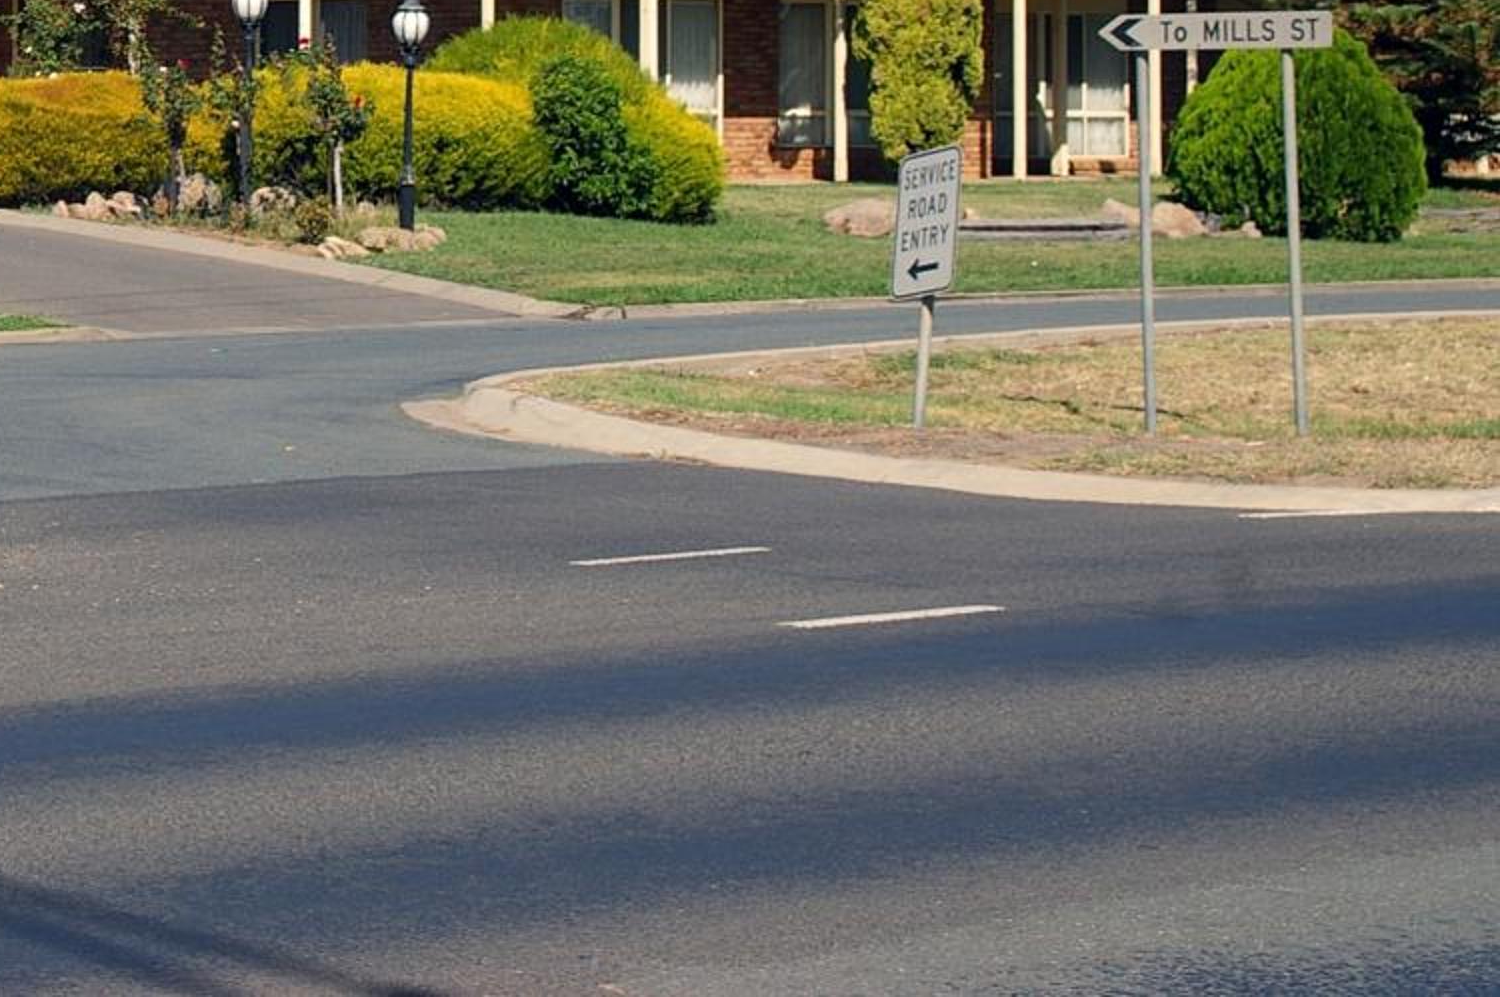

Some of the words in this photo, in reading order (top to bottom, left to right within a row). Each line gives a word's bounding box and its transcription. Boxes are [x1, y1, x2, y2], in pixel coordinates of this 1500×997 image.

[1161, 20, 1187, 44] To
[1203, 19, 1276, 43] MILLS
[1291, 18, 1320, 42] ST
[904, 158, 956, 191] SERVICE
[907, 193, 948, 220] ROAD
[901, 224, 949, 252] ENTRY
